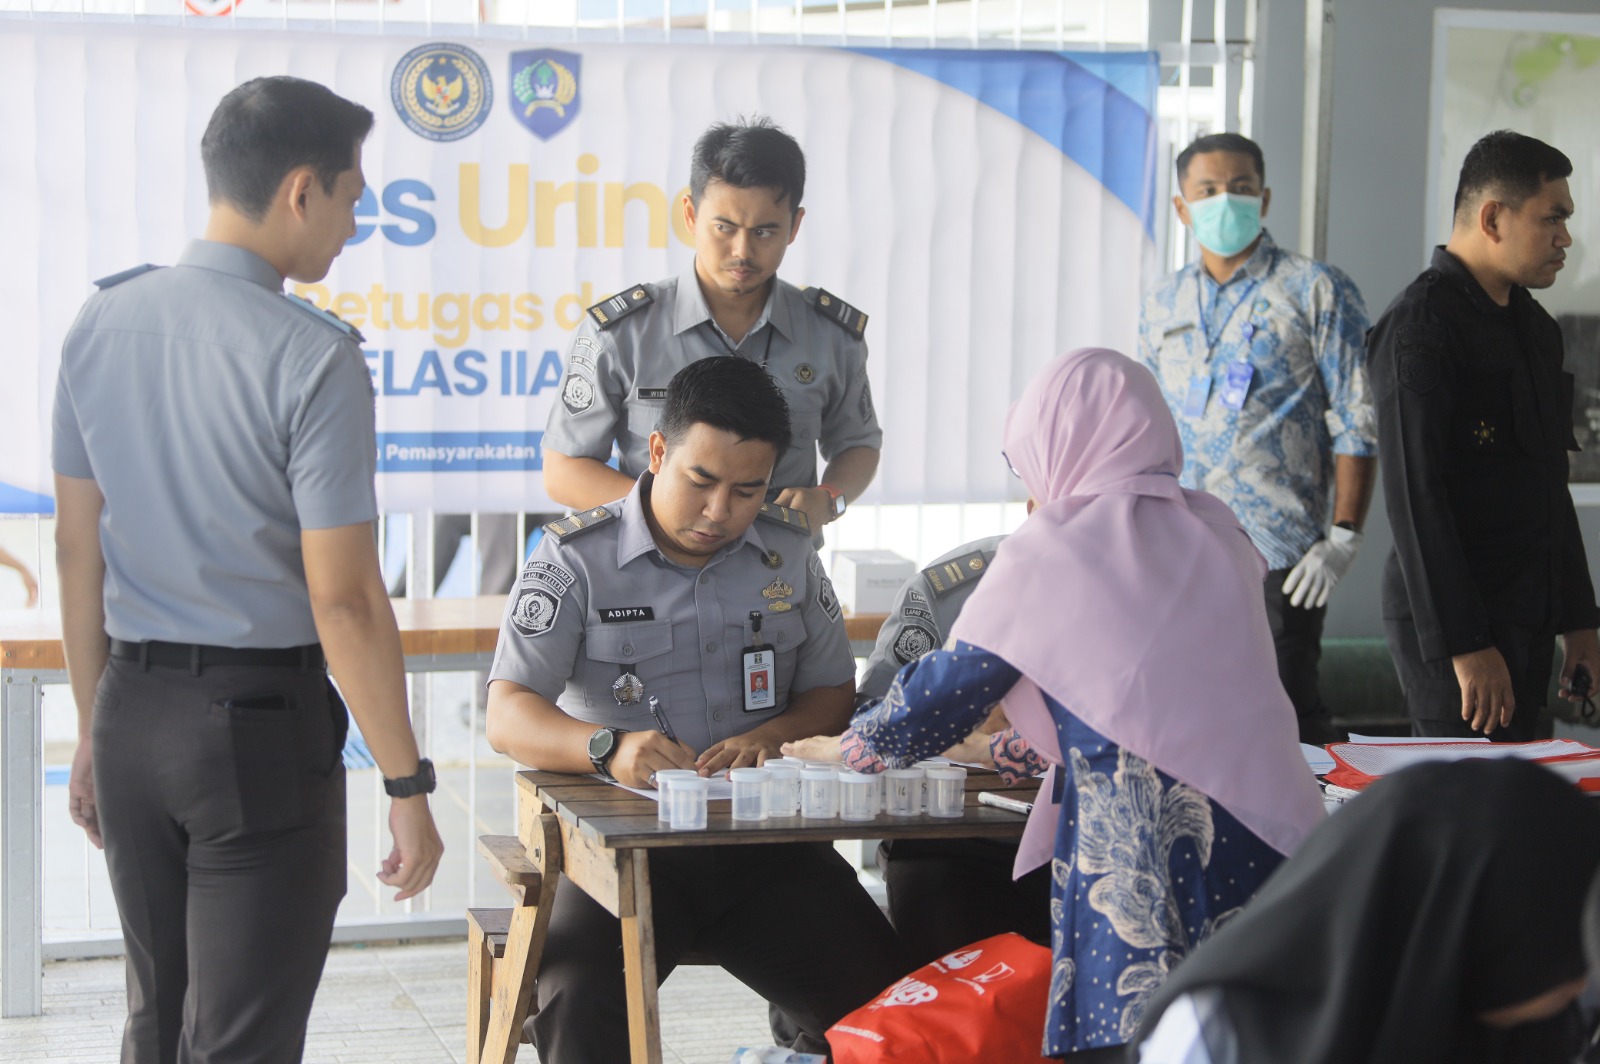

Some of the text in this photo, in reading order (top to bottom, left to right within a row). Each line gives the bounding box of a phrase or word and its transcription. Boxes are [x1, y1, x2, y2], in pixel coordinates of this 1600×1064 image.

[554, 281, 613, 331] d
[386, 443, 535, 464] Pemasyarakatan
[608, 609, 645, 618] ADIPTA
